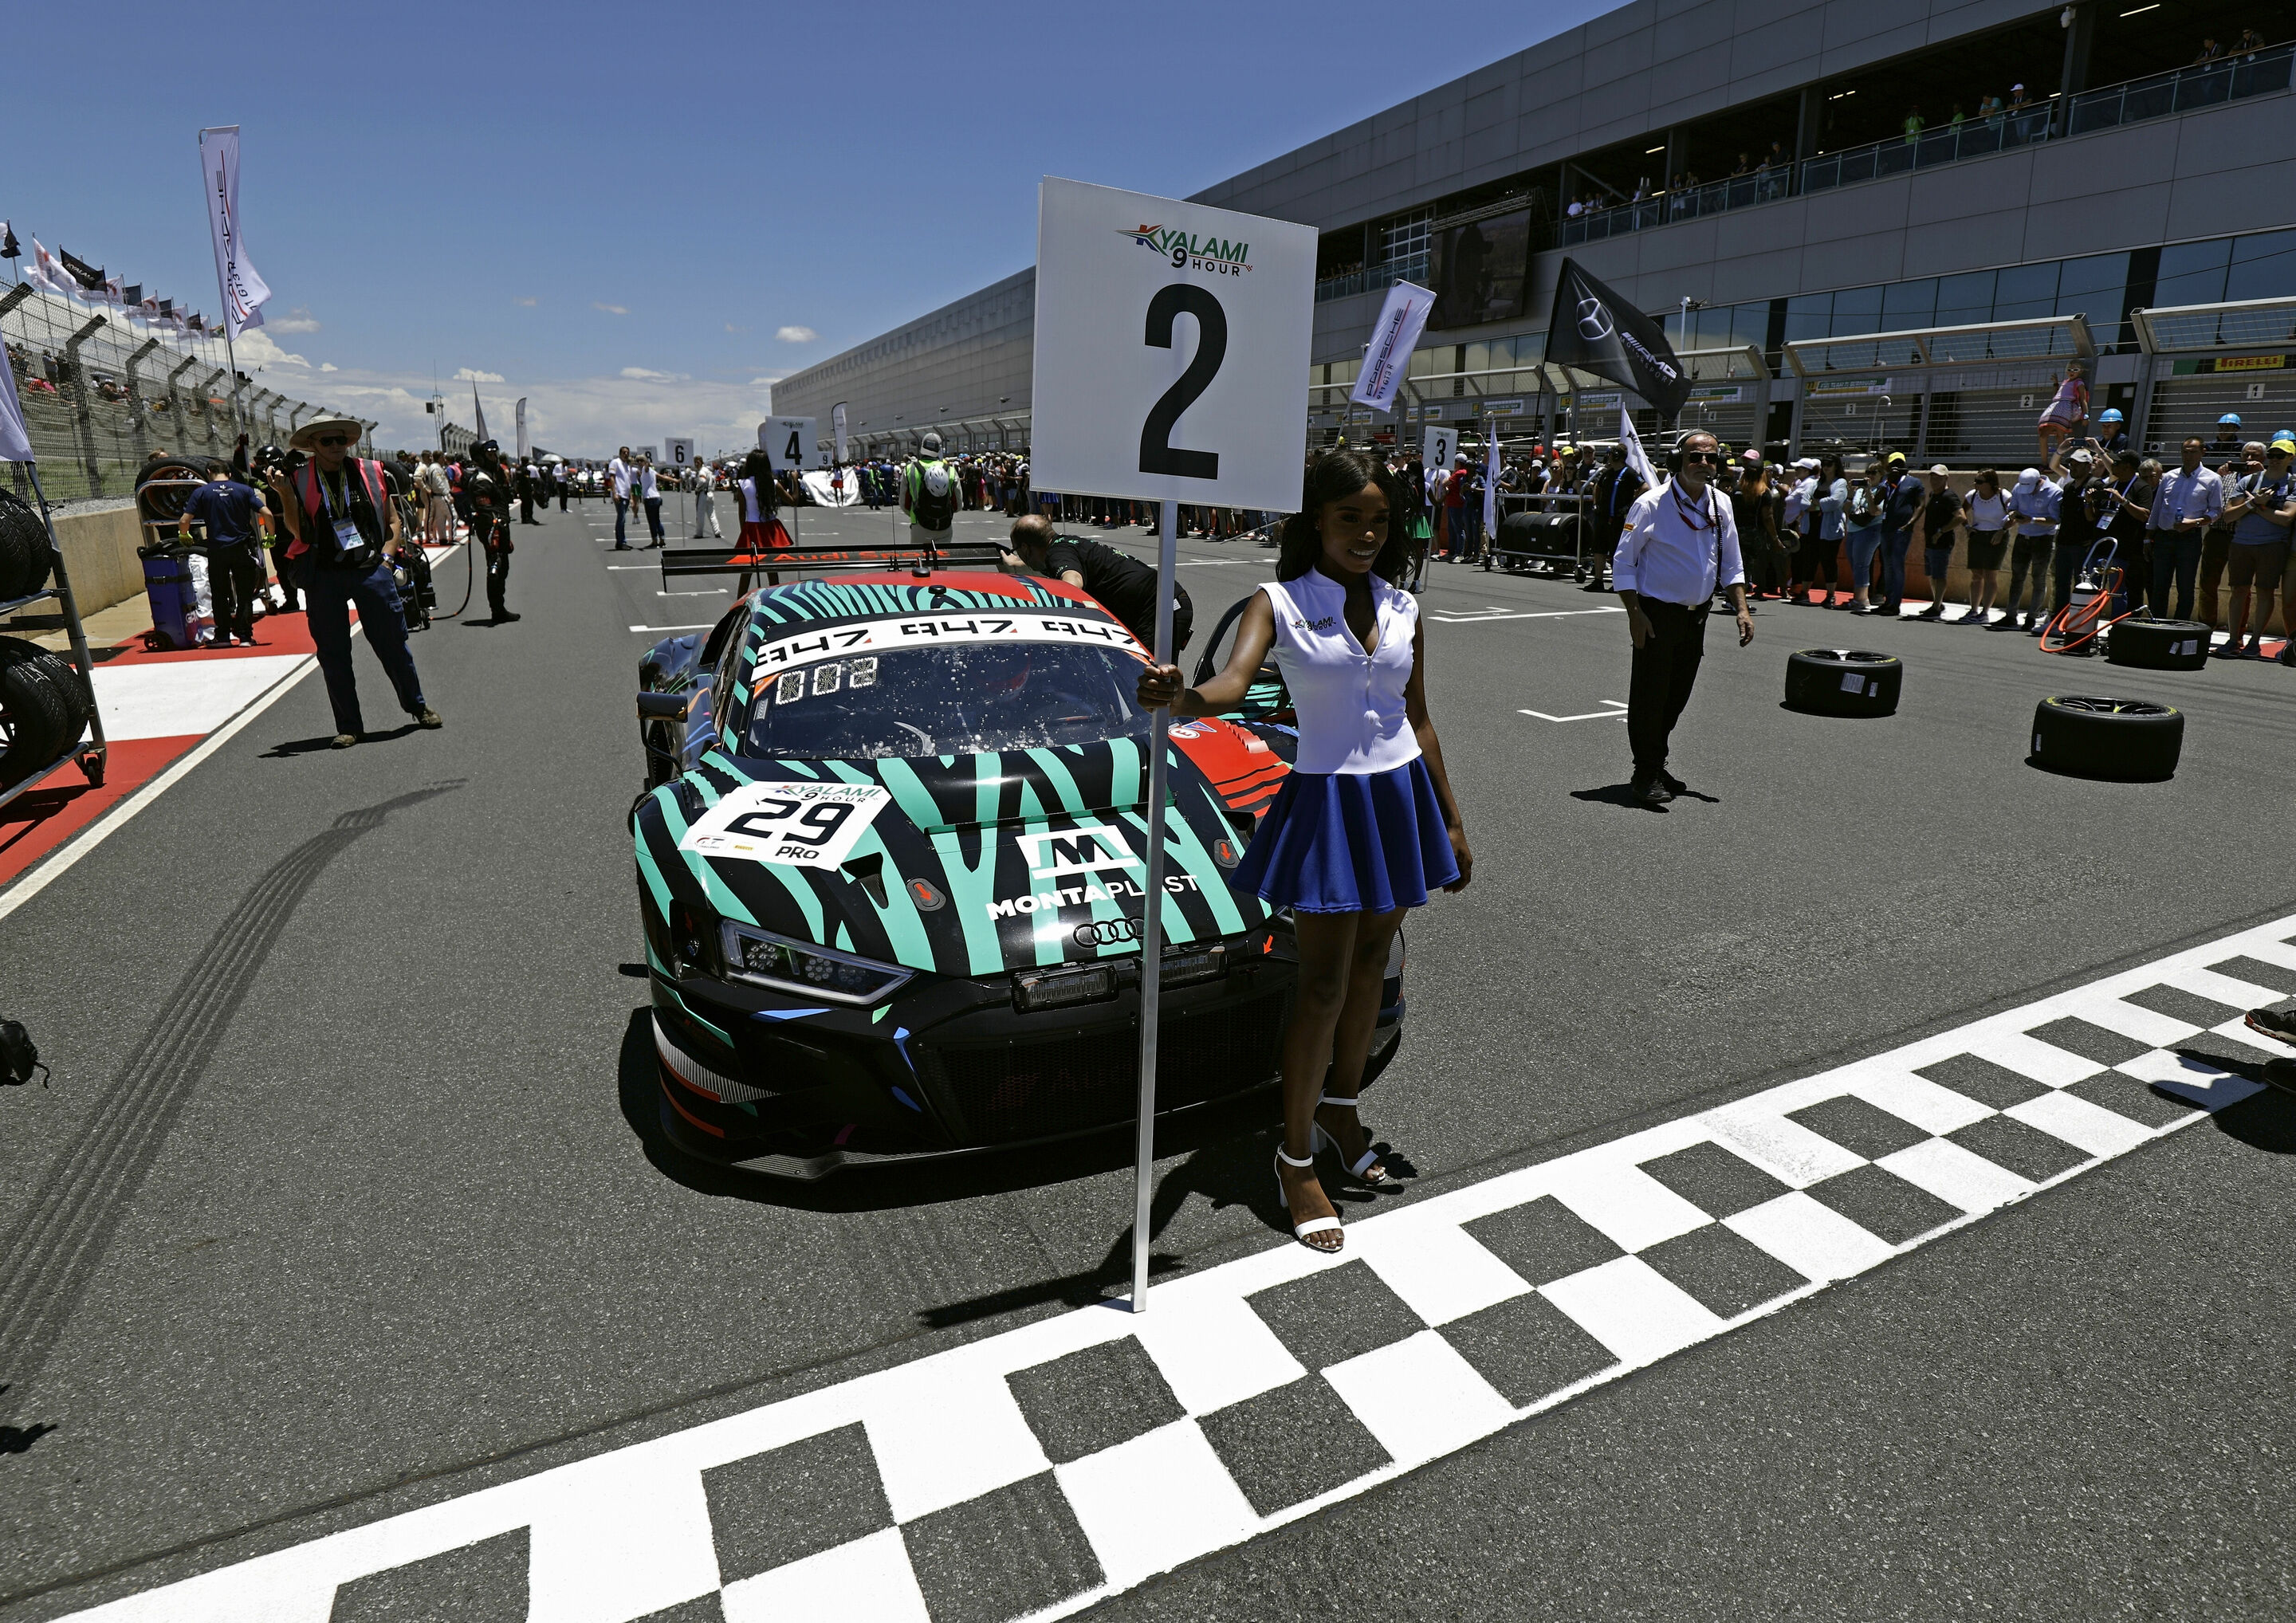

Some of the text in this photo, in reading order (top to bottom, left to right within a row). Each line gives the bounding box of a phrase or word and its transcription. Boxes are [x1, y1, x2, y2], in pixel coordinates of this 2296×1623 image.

[1118, 224, 1249, 264] KYALAMI
[1171, 247, 1240, 277] 9 HOUR
[1366, 307, 1404, 397] PORSCHE
[1619, 336, 1674, 386] MOTORSPORT
[2220, 356, 2279, 367] PIRELLI
[1138, 283, 1228, 480] 2
[1376, 387, 1386, 399] 911
[1382, 370, 1392, 385] GT3
[2252, 385, 2259, 397] 1
[2023, 396, 2030, 407] 2
[674, 444, 685, 463] 6
[784, 431, 802, 466] 4
[822, 454, 828, 465] 9
[1435, 438, 1446, 466] 3
[772, 552, 849, 562] Audi
[899, 620, 1013, 636] 947
[1041, 621, 1136, 645] 947
[1292, 616, 1334, 629] KYALAMI
[757, 629, 870, 666] 947
[769, 784, 882, 797] KYALAMI
[800, 792, 819, 801] 9
[723, 798, 855, 846] 29
[775, 846, 820, 859] PRO
[985, 874, 1198, 921] MONTAPLST
